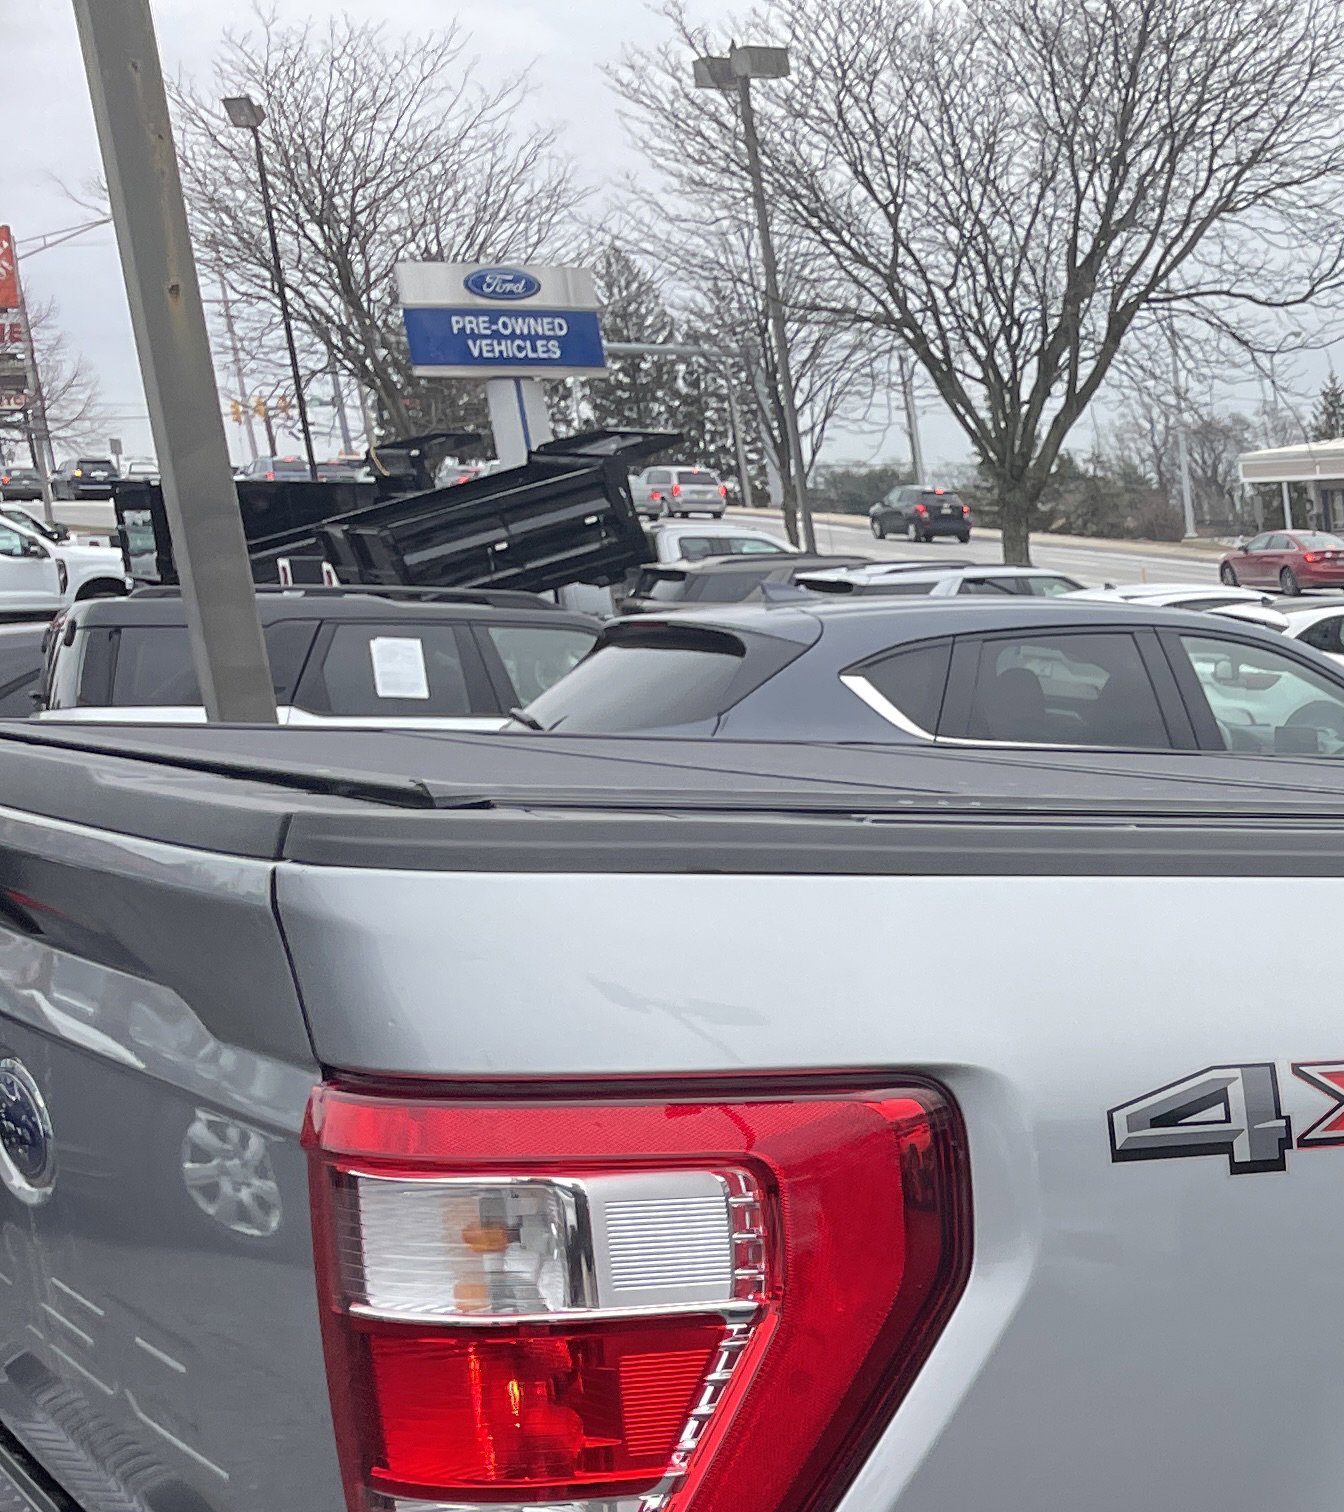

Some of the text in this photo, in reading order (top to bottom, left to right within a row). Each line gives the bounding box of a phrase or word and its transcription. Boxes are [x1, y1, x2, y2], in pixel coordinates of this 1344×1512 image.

[481, 274, 527, 294] Ford
[450, 315, 569, 337] PRE-OWNED
[467, 338, 562, 360] VEHICLES
